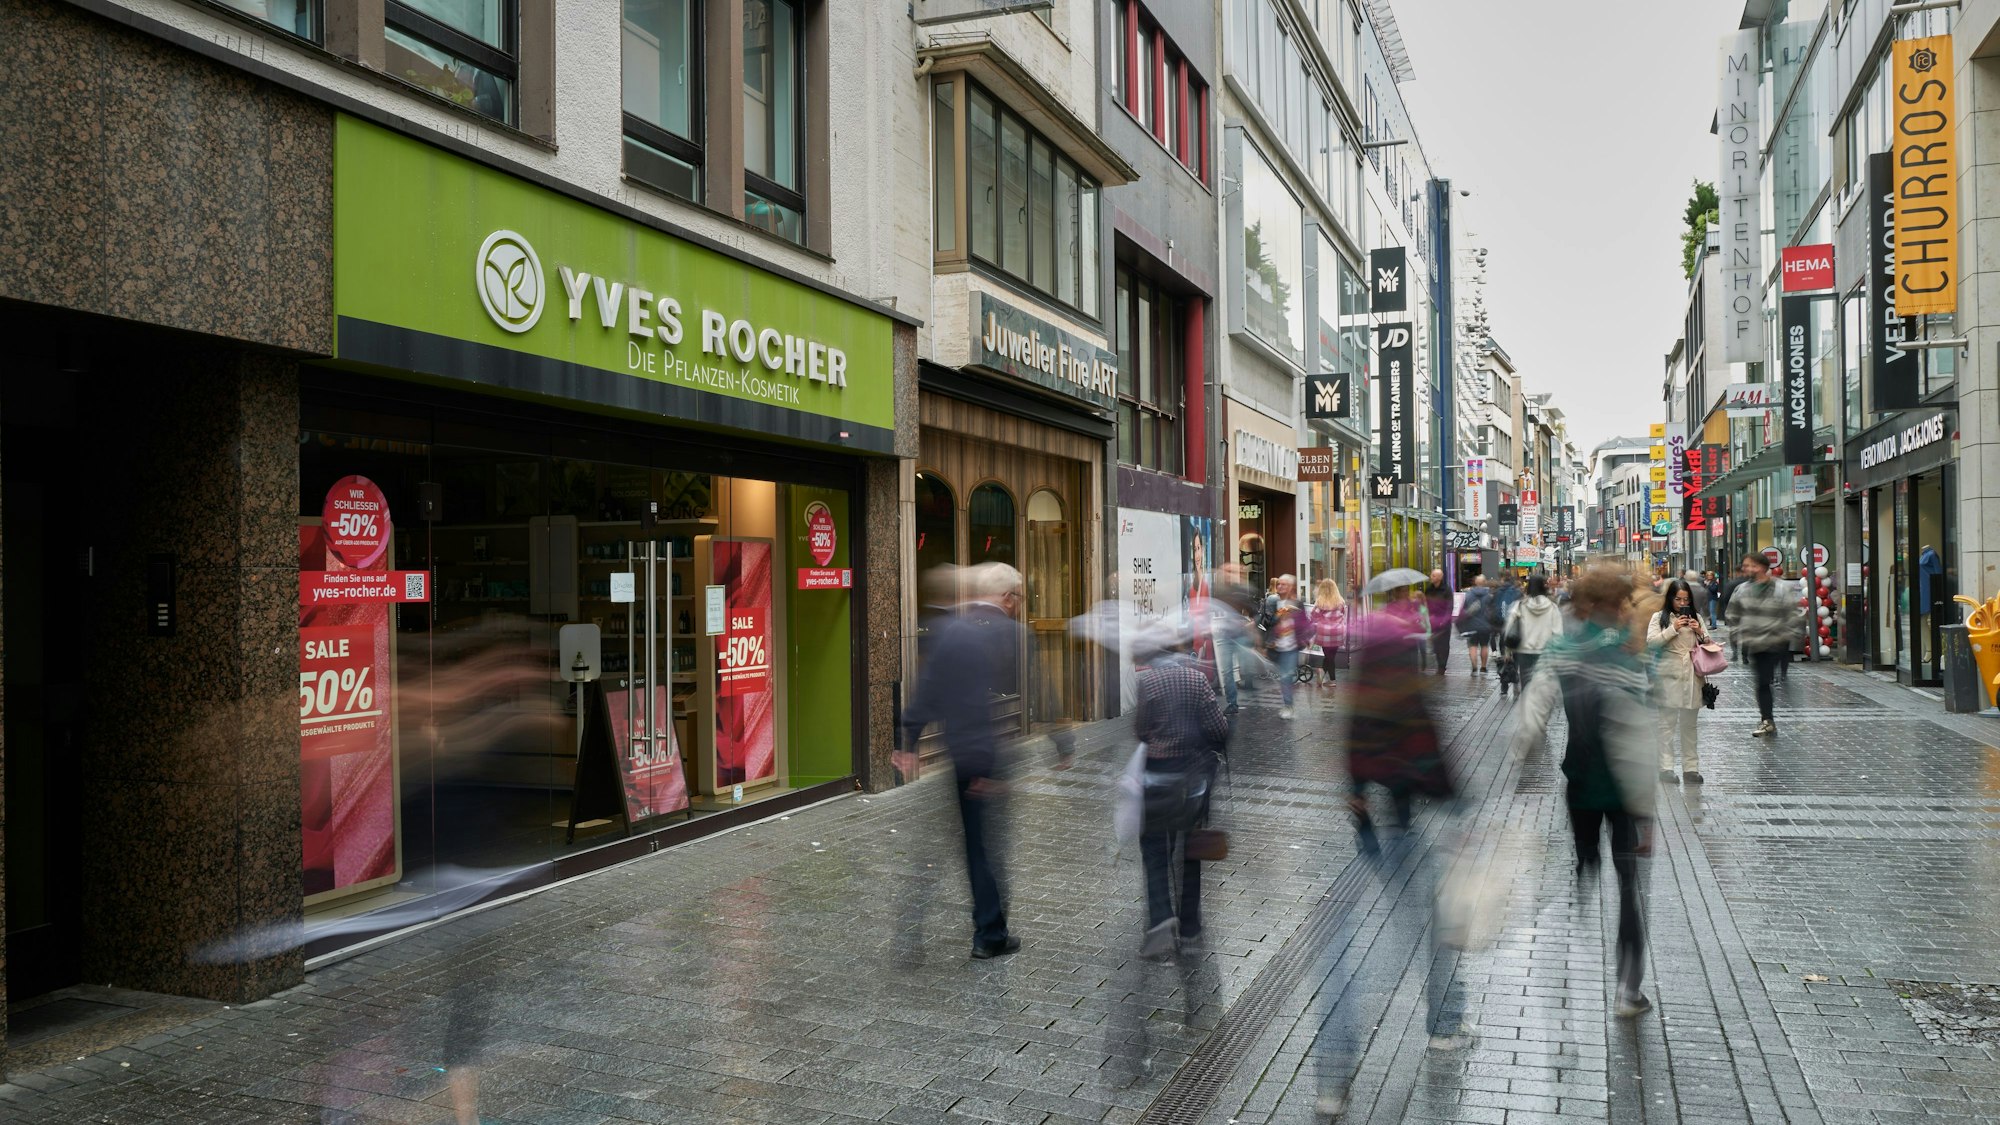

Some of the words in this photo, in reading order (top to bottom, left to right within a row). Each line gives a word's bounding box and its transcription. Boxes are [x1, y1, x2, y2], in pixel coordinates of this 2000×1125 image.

[1728, 52, 1752, 339] MINORITENHOF
[1899, 79, 1949, 294] CHURROS
[1785, 257, 1831, 273] HEMA
[1377, 266, 1399, 293] WMF
[558, 265, 684, 346] YVES
[702, 309, 848, 389] ROCHER
[1381, 328, 1409, 349] JD
[983, 311, 1057, 375] Juwelier
[1057, 340, 1089, 388] Fine
[1091, 358, 1118, 399] ART
[1790, 324, 1806, 430] JACK&JONES
[1313, 379, 1341, 413] WMF
[1390, 359, 1401, 419] TRAINERS
[1731, 389, 1763, 405] HM
[1391, 432, 1401, 461] KING
[1860, 444, 1876, 470] VERO
[1876, 435, 1897, 464] MODA
[1900, 413, 1944, 455] JACK&JONES
[1300, 455, 1331, 464] ELBEN
[1668, 435, 1684, 495] claire's
[1301, 465, 1330, 474] WALD
[349, 489, 364, 499] WIR
[1377, 476, 1393, 495] WMF
[334, 500, 379, 511] SCHLIESSEN
[1238, 511, 1260, 519] ARS
[1705, 496, 1717, 515] Foo
[331, 513, 377, 537] -50%
[812, 532, 831, 547] -50%
[1133, 558, 1152, 574] SHINE
[323, 574, 349, 583] Finden
[349, 574, 361, 583] Sie
[362, 575, 375, 583] uns
[375, 574, 387, 582] auf
[806, 577, 839, 587] yves-rocher.de
[1133, 578, 1156, 595] BRIGHT
[313, 584, 397, 602] yves-rocher.de
[732, 617, 753, 630] SALE
[305, 639, 350, 660] SALE
[719, 635, 764, 668] -50%
[301, 724, 342, 737] USGEWÄHLTE
[343, 721, 375, 732] PRODUKTE
